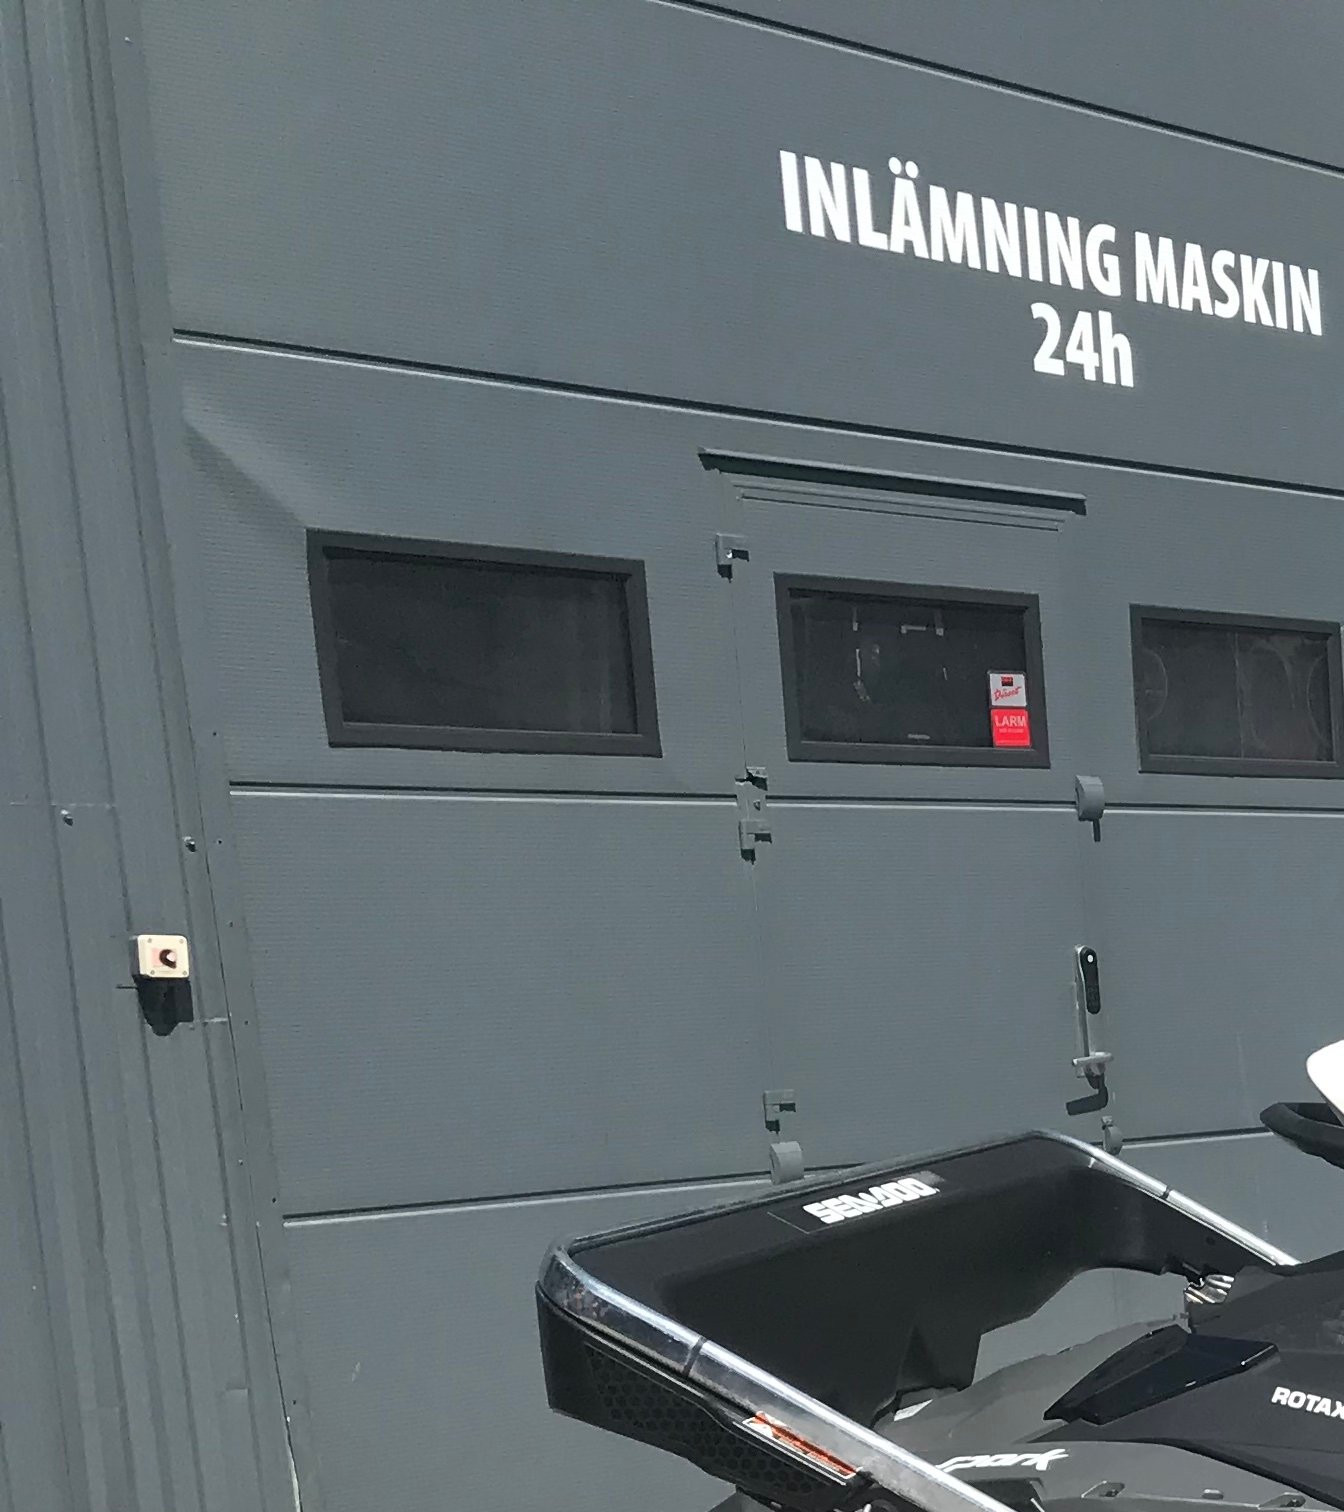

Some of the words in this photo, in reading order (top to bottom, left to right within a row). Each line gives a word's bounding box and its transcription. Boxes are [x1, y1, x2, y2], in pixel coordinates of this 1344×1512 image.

[779, 149, 1122, 298] INLÄMNING
[1134, 230, 1323, 336] MASKIN
[1030, 302, 1134, 388] 24h
[994, 715, 1027, 727] LARM
